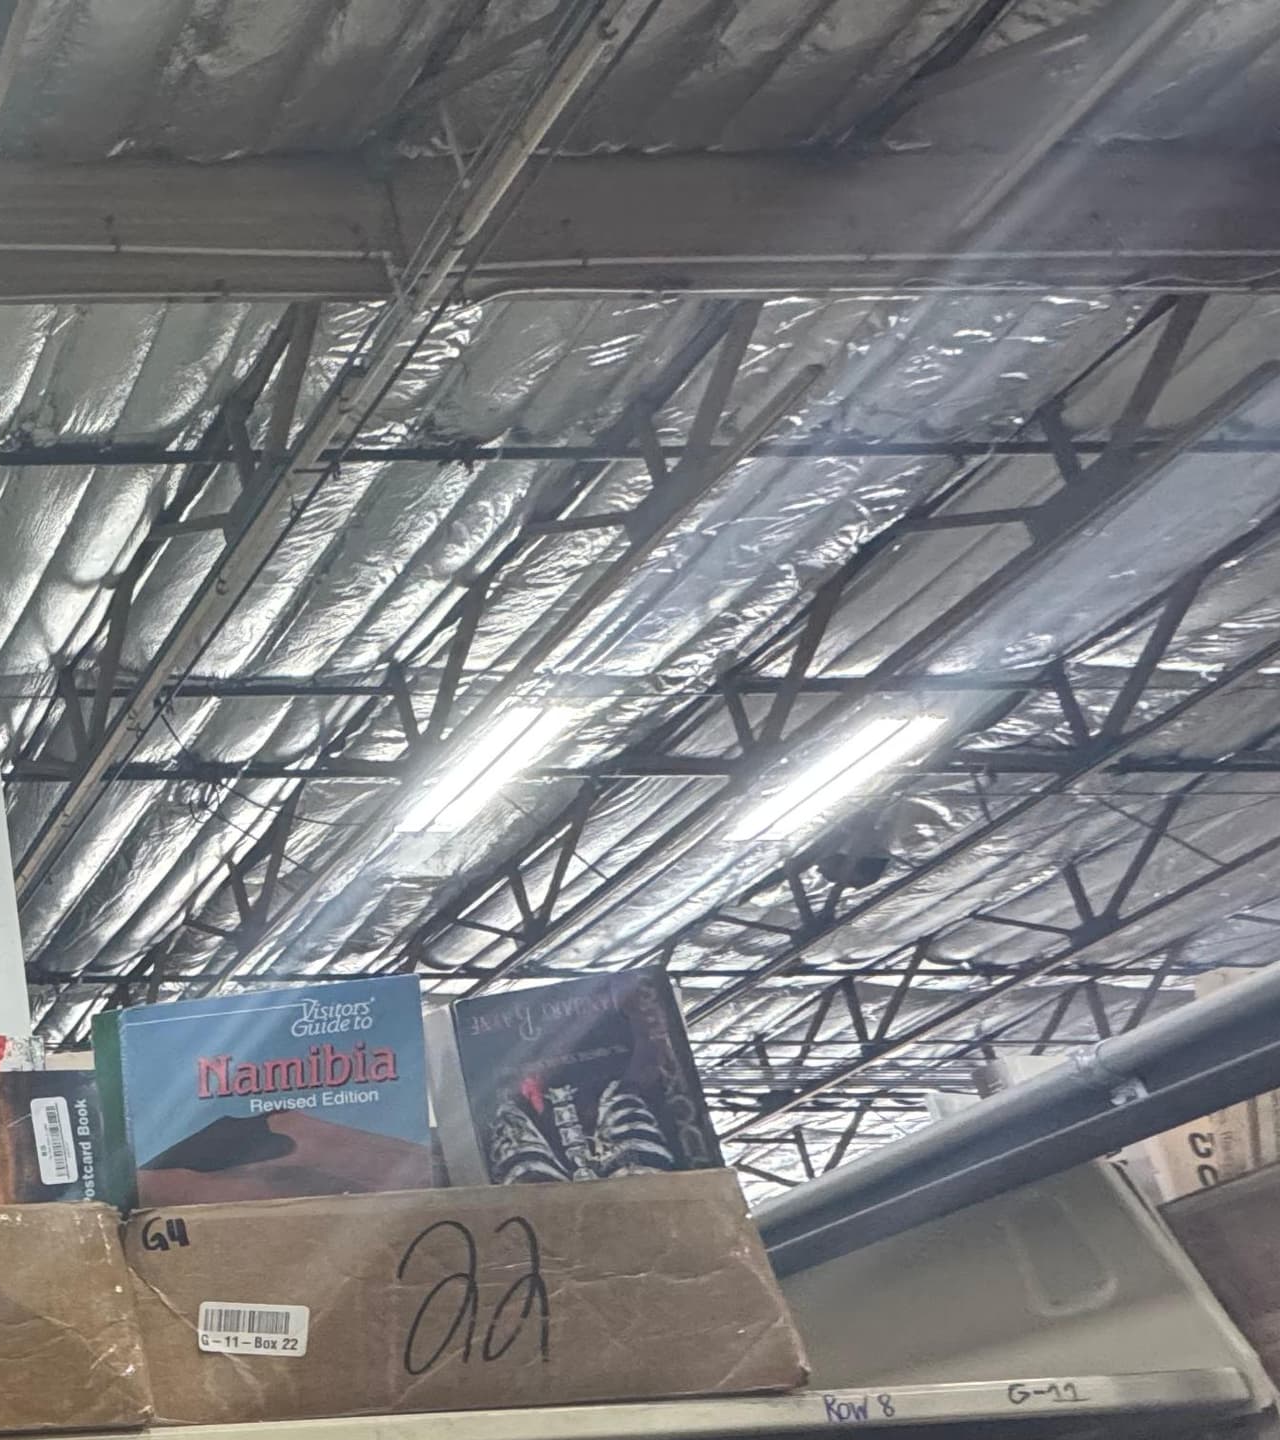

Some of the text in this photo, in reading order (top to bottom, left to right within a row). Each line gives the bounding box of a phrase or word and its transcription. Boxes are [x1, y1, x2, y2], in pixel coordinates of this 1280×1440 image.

[291, 1014, 374, 1039] Guide to
[197, 1041, 399, 1100] Namibia
[250, 1089, 379, 1114] Revised Edition
[75, 1098, 90, 1136] Book
[397, 1215, 552, 1376] 22
[281, 1337, 299, 1351] 22
[880, 1394, 896, 1417] 8
